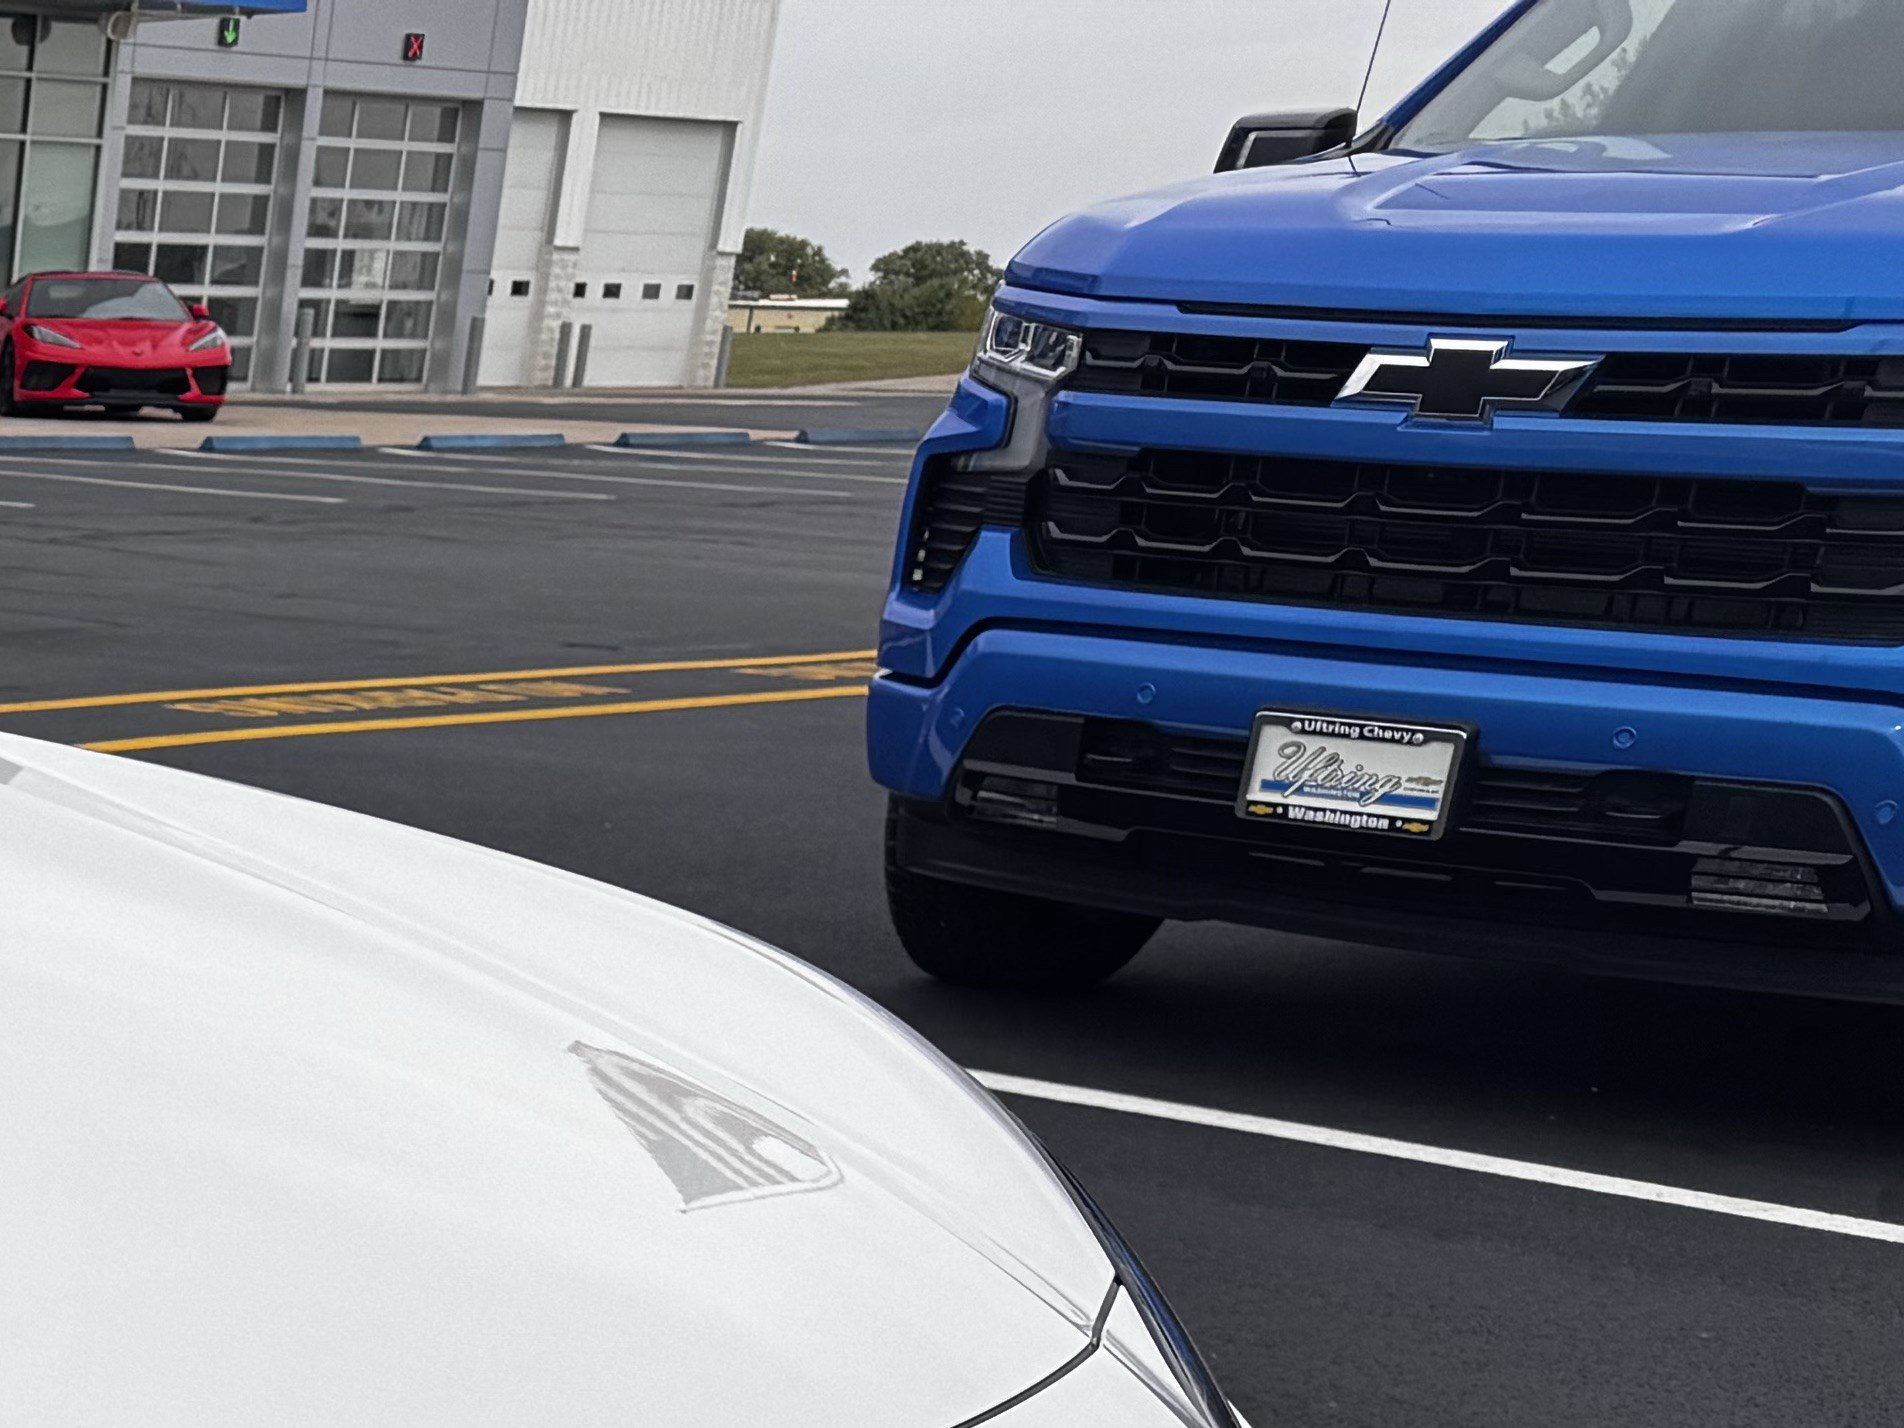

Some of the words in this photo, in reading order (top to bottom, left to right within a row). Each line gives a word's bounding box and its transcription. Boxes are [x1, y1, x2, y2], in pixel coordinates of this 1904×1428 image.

[1304, 719, 1360, 739] Uftring
[1362, 725, 1412, 744] Chevy
[1272, 740, 1403, 807] Uftring
[1287, 805, 1390, 829] Washington
